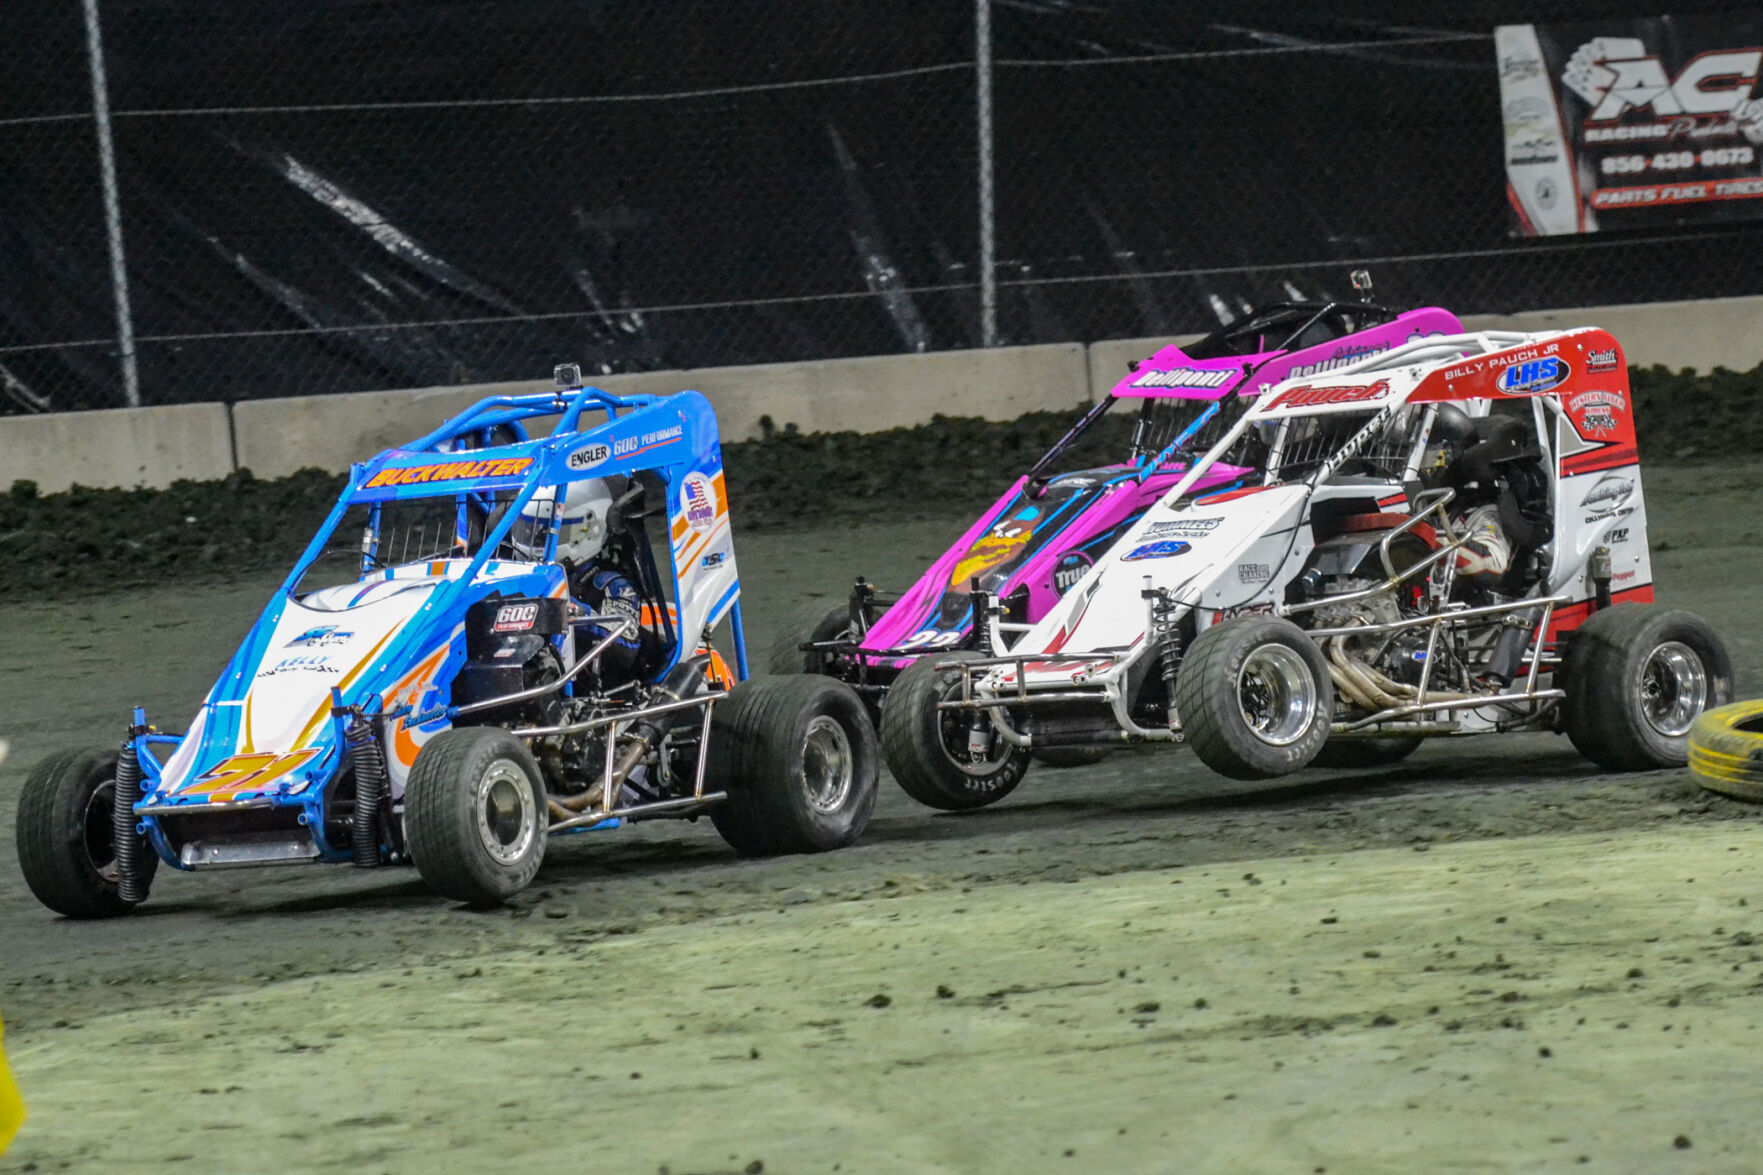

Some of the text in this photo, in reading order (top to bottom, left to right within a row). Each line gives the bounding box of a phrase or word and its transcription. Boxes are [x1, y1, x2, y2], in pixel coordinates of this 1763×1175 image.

[1584, 124, 1668, 142] RACING
[1595, 188, 1657, 206] PARTS
[1444, 361, 1484, 381] BILLY
[1489, 350, 1538, 368] PAUCH
[1542, 343, 1560, 355] JR
[1586, 348, 1616, 365] Smith
[1506, 357, 1559, 388] LHS
[613, 424, 683, 456] 600 PERFORMANCE
[571, 445, 608, 467] ENGLER
[364, 457, 536, 489] BUCKWALTER
[497, 605, 536, 622] 600
